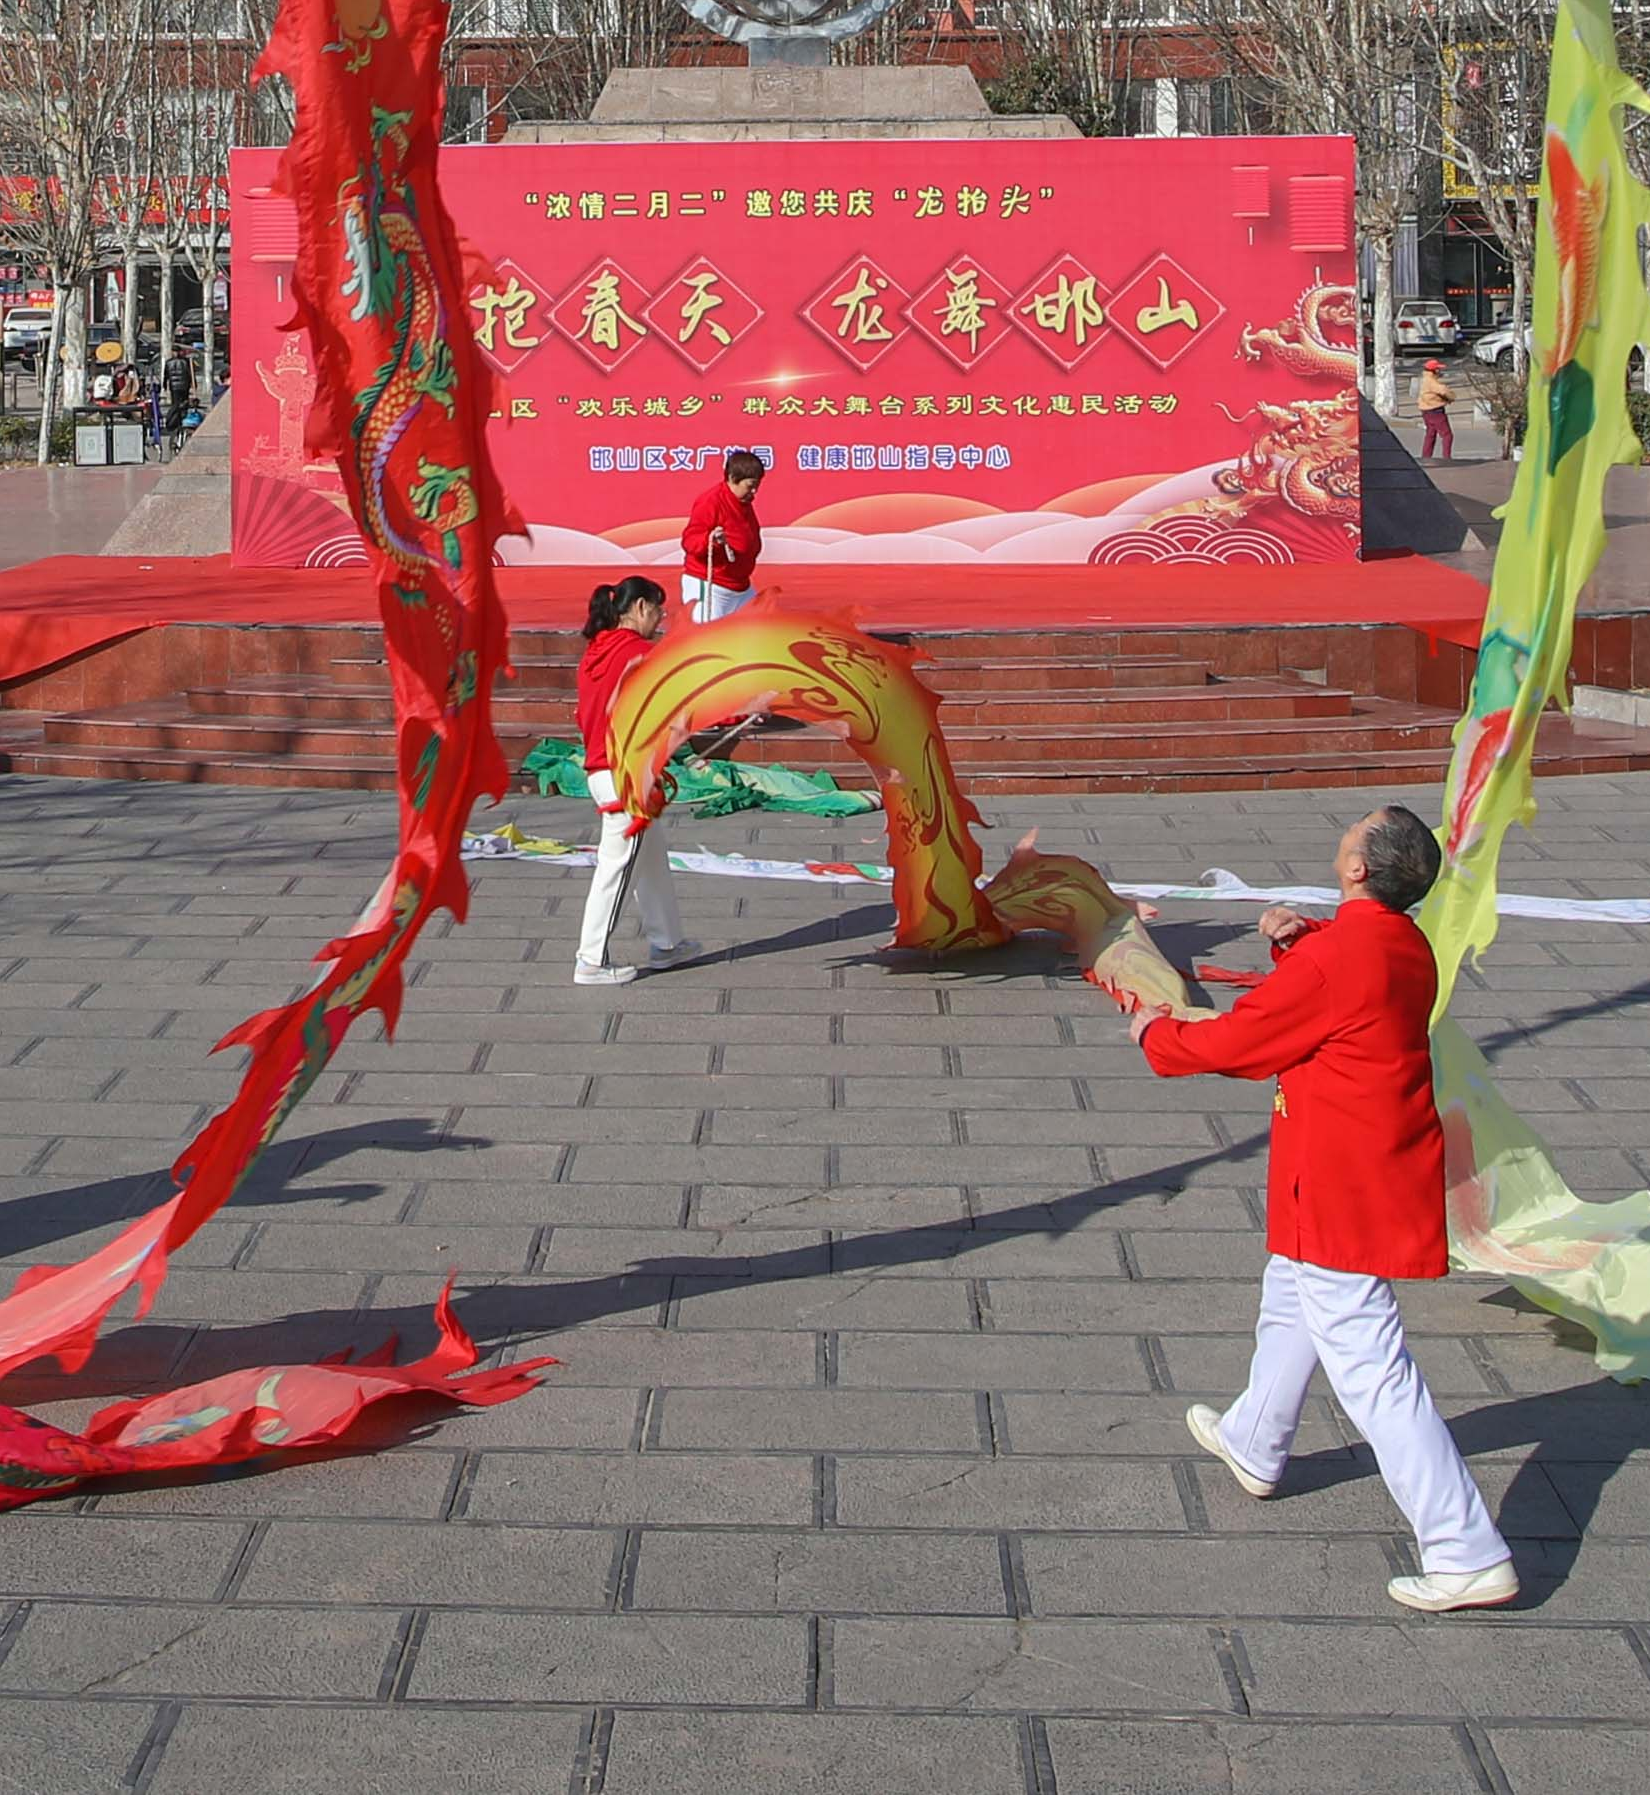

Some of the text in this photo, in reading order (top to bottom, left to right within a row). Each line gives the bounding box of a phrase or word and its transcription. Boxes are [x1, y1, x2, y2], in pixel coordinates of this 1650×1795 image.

[524, 184, 1055, 219] “浓情二月二” 邀您共庆 “龙抬头”
[830, 266, 1200, 355] 龙舞邯山
[488, 397, 539, 419] 区
[741, 393, 1179, 418] 群众大舞台系列文化惠民活动
[588, 444, 1011, 473] 邯山区文广局 健康邯山指导中心
